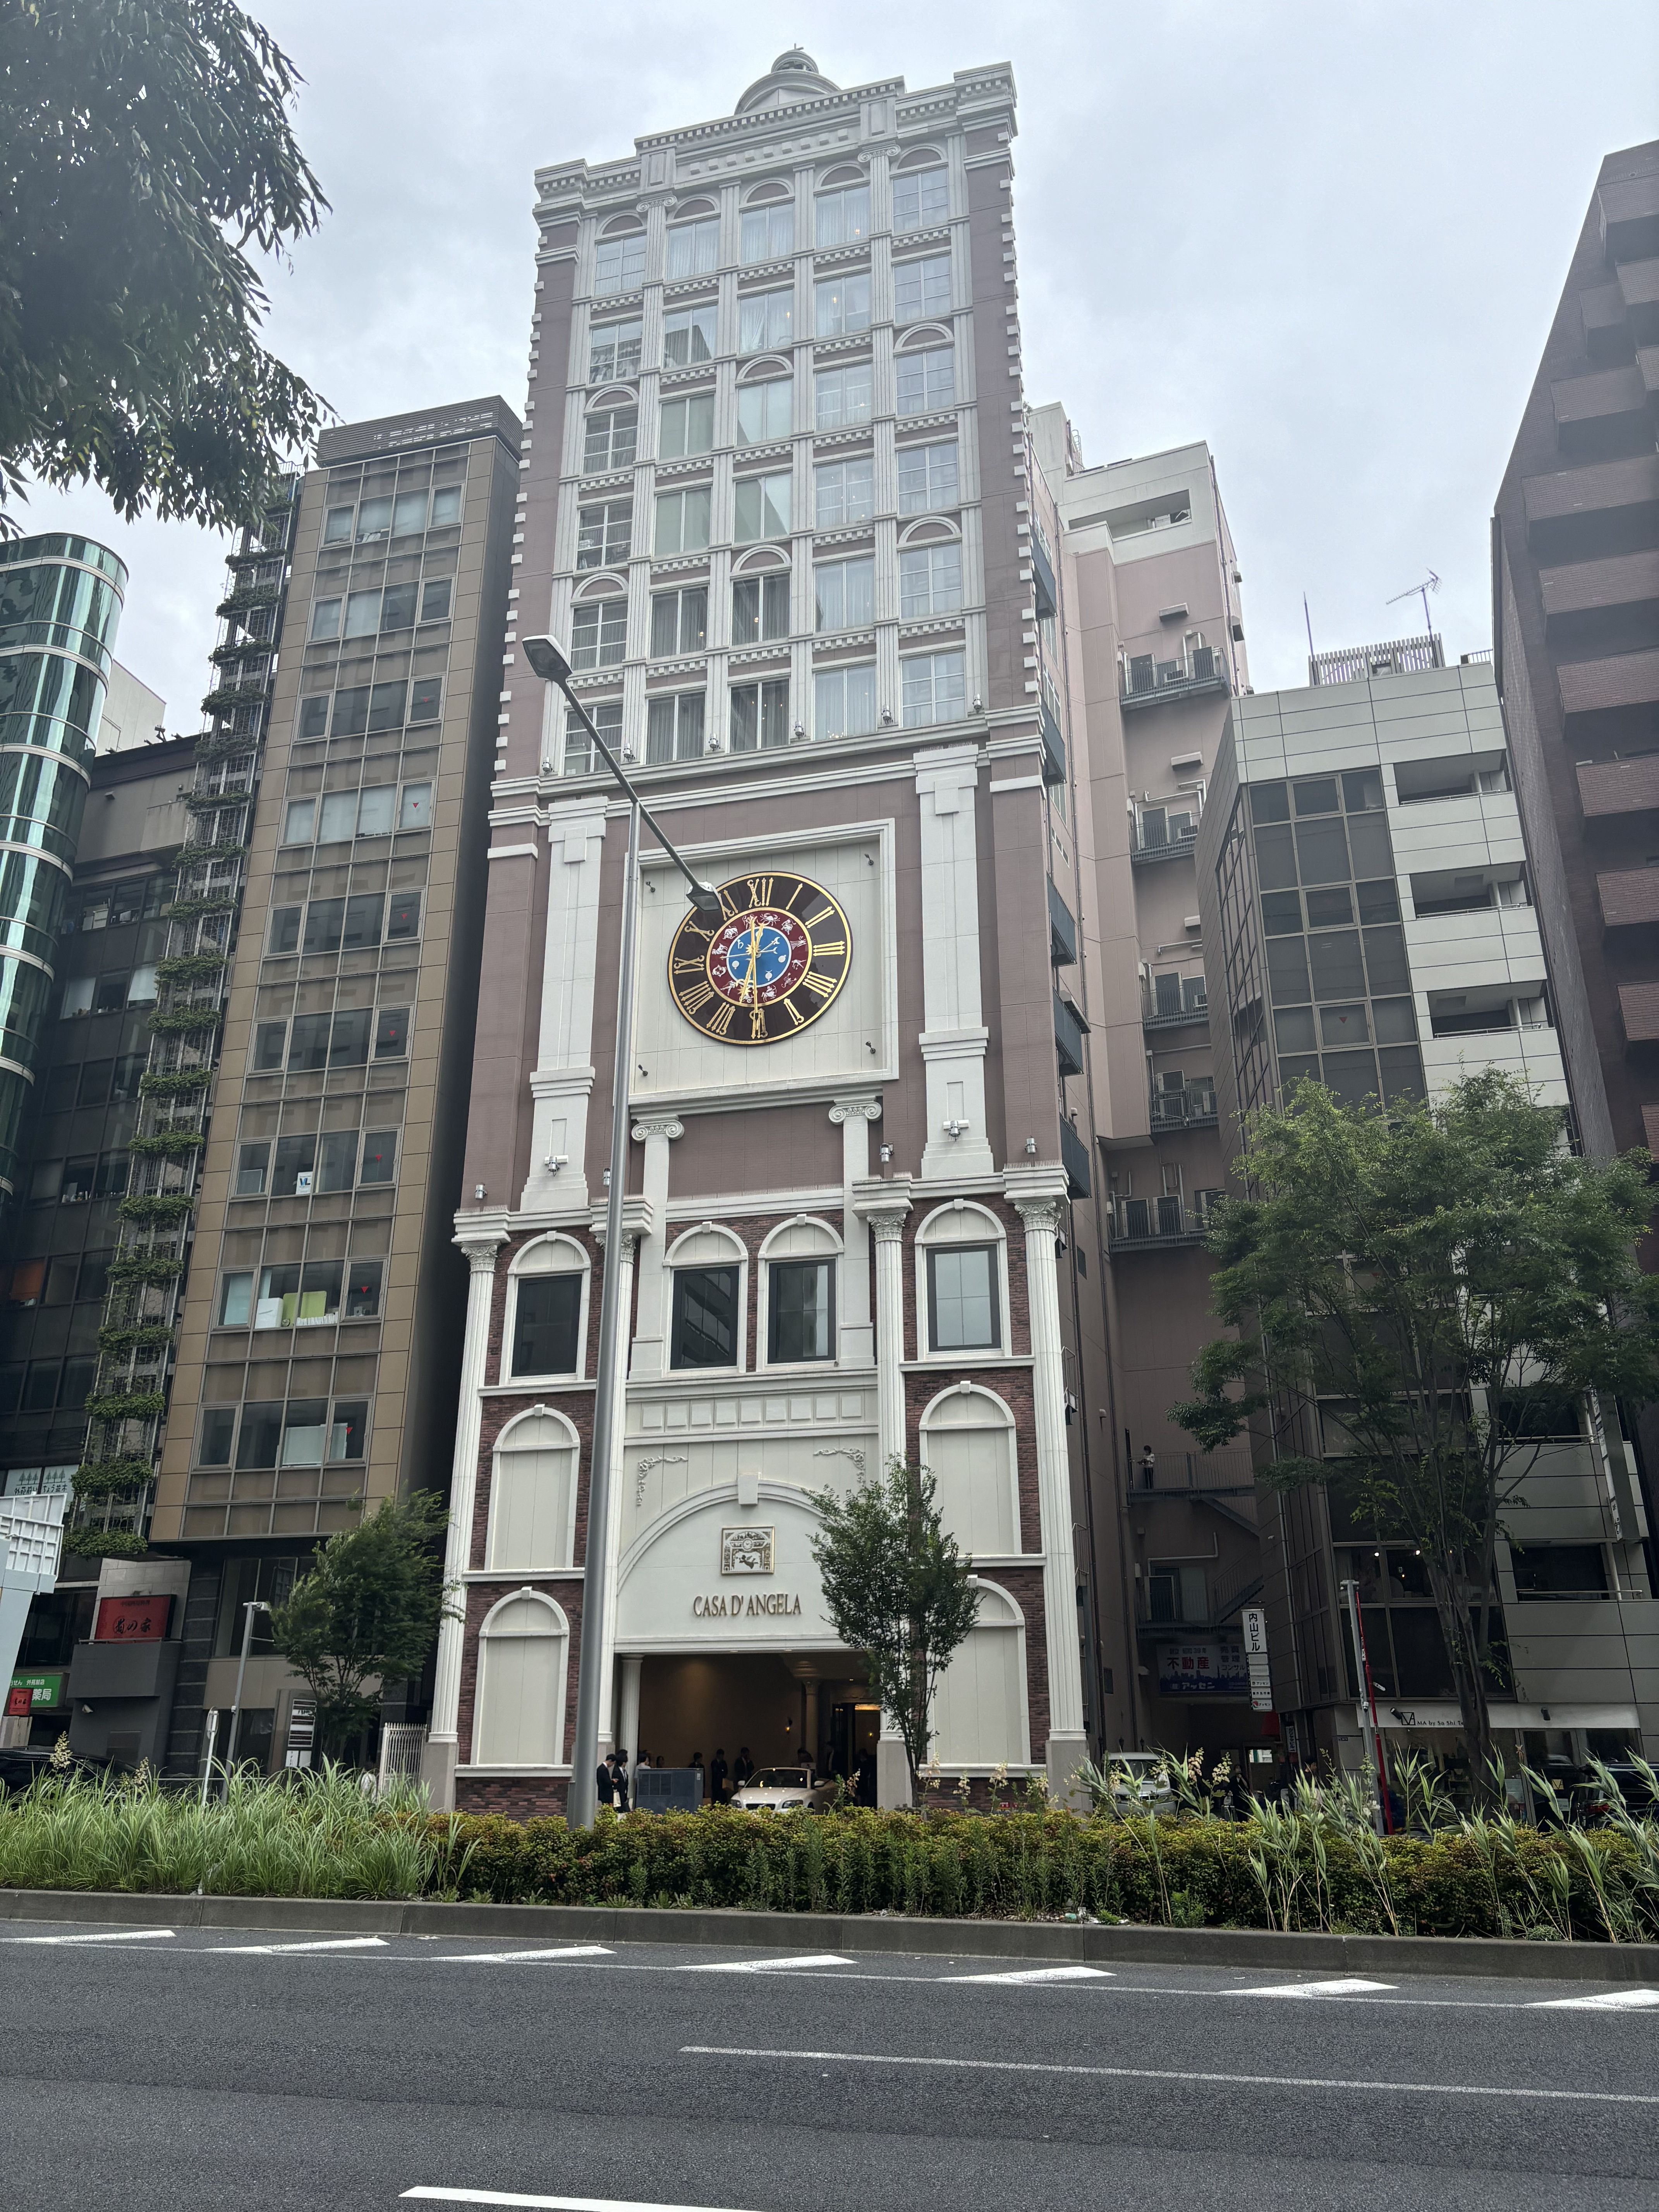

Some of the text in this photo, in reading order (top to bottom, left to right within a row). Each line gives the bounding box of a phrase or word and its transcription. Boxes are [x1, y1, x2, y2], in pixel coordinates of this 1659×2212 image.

[747, 877, 774, 908] XII
[785, 883, 803, 910] I
[805, 906, 835, 928] II
[685, 921, 714, 941] X
[813, 940, 845, 957] III
[673, 955, 704, 974] IX
[783, 998, 804, 1025] V
[693, 1595, 727, 1616] CASA
[1249, 1613, 1260, 1651] 内山ビル
[1167, 1656, 1210, 1669] 不動産
[32, 1688, 52, 1701] 薬局
